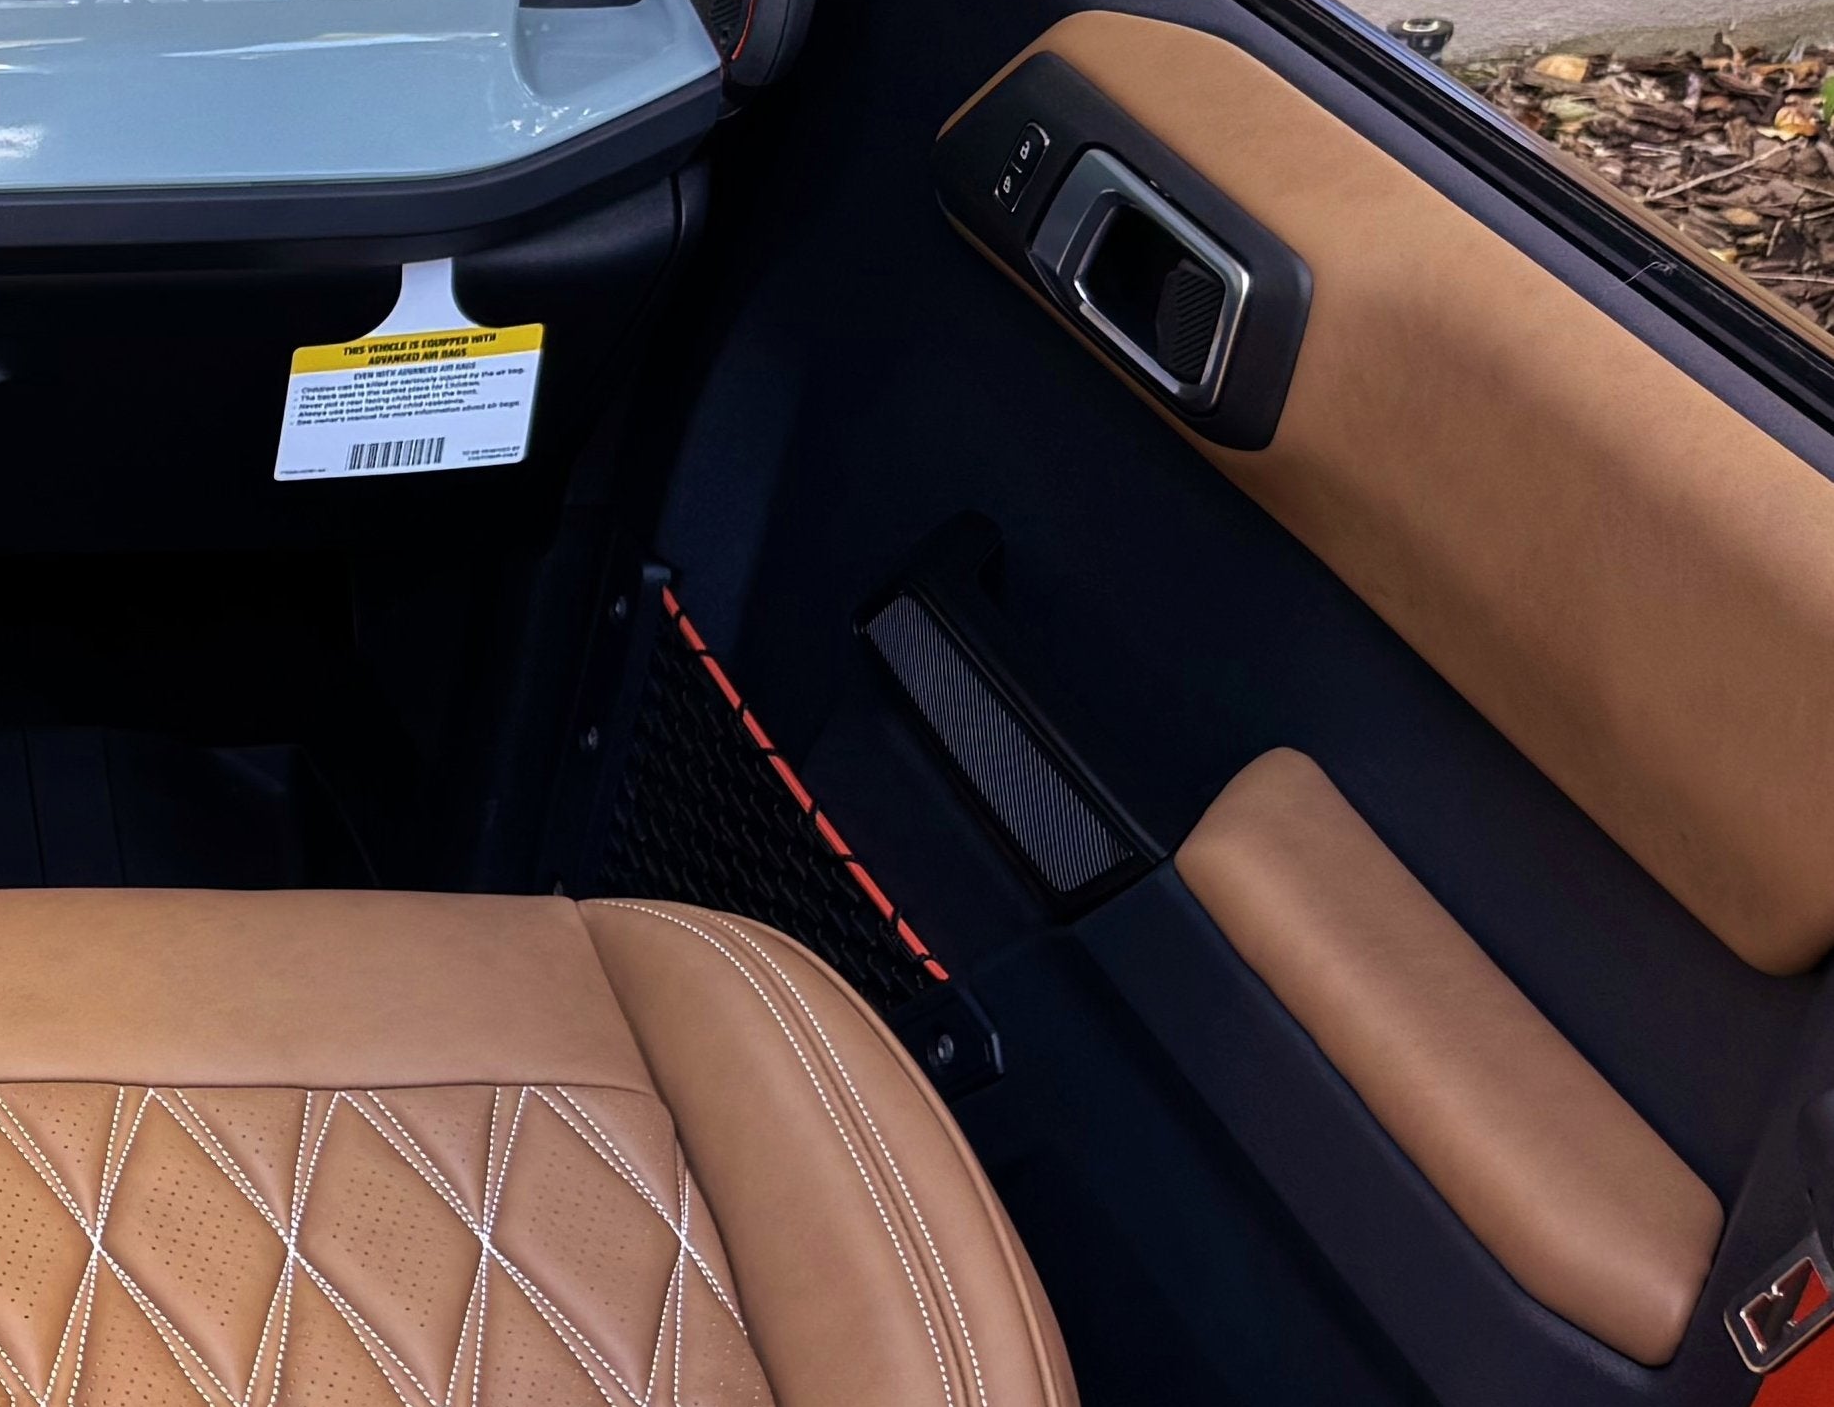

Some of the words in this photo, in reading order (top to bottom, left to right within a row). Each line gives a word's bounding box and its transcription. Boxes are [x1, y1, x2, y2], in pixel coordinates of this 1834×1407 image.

[343, 345, 365, 356] THIS
[368, 342, 407, 354] VEHICLE
[408, 340, 419, 350] IS
[421, 336, 470, 349] EQUIPPED
[471, 333, 497, 344] WITH
[368, 353, 420, 365] ADVANCED
[421, 350, 440, 360] AIR
[441, 348, 467, 358] BAGS
